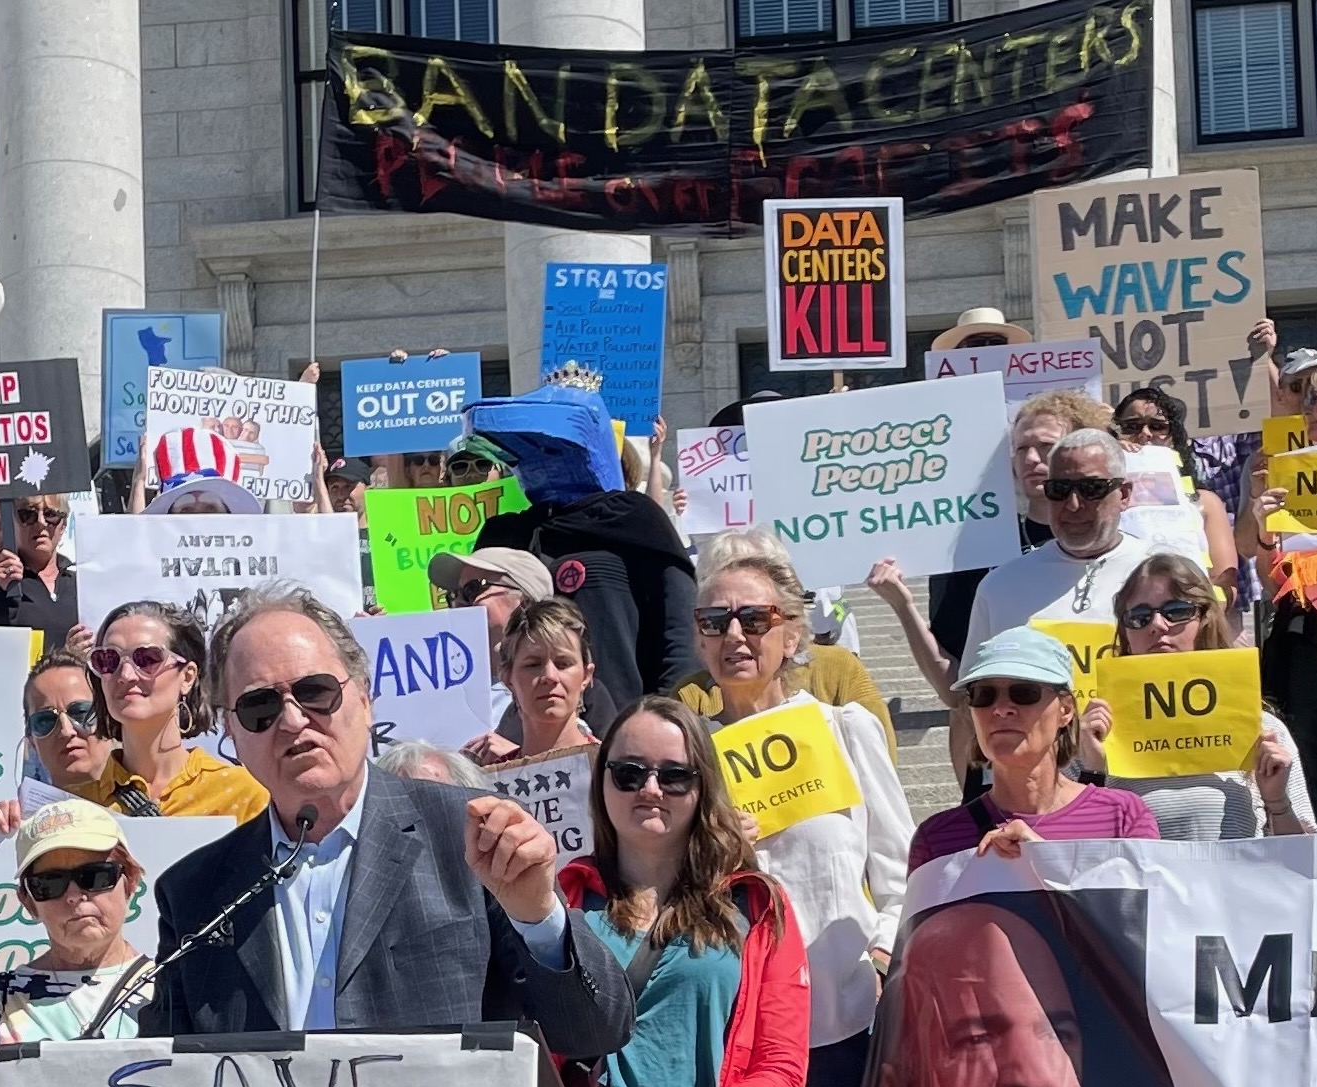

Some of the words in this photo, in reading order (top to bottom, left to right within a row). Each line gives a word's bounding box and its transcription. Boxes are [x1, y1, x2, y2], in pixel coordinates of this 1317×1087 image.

[341, 44, 572, 146] BAN
[605, 55, 852, 166] DATA
[783, 211, 885, 247] DATA
[1058, 187, 1224, 251] MAKE
[554, 268, 666, 290] STRATOS
[782, 248, 886, 283] CENTERS
[1053, 250, 1252, 320] WAVES
[555, 320, 577, 334] AIR
[785, 282, 887, 354] KILL
[554, 339, 598, 354] WATER
[1089, 311, 1205, 371] NOT
[1007, 350, 1094, 378] AGREES
[149, 369, 237, 396] FOLLOW
[243, 378, 285, 400] THE
[356, 382, 383, 394] KEEP
[385, 381, 415, 392] DATA
[416, 377, 465, 390] CENTERS
[150, 391, 228, 418] MONEY
[232, 400, 261, 422] OF
[264, 404, 316, 426] THIS
[357, 392, 420, 418] OUT
[425, 390, 466, 413] OF
[357, 419, 382, 431] BOX
[384, 417, 417, 429] ELDER
[418, 414, 464, 427] COUNTY
[801, 414, 952, 462] Protect
[677, 428, 734, 469] STOP
[811, 449, 947, 496] People
[416, 486, 505, 536] NOT
[774, 510, 848, 544] NOT
[860, 491, 1000, 535] SHARKS
[1288, 507, 1314, 518] DATA
[176, 535, 254, 548] O'LEARY
[161, 557, 242, 578] UTAH
[247, 556, 279, 576] IN
[372, 632, 475, 701] AND
[1143, 678, 1218, 720] NO
[723, 733, 798, 784] NO
[1133, 738, 1169, 753] DATA
[1172, 733, 1232, 750] CENTER
[769, 777, 826, 808] CENTER
